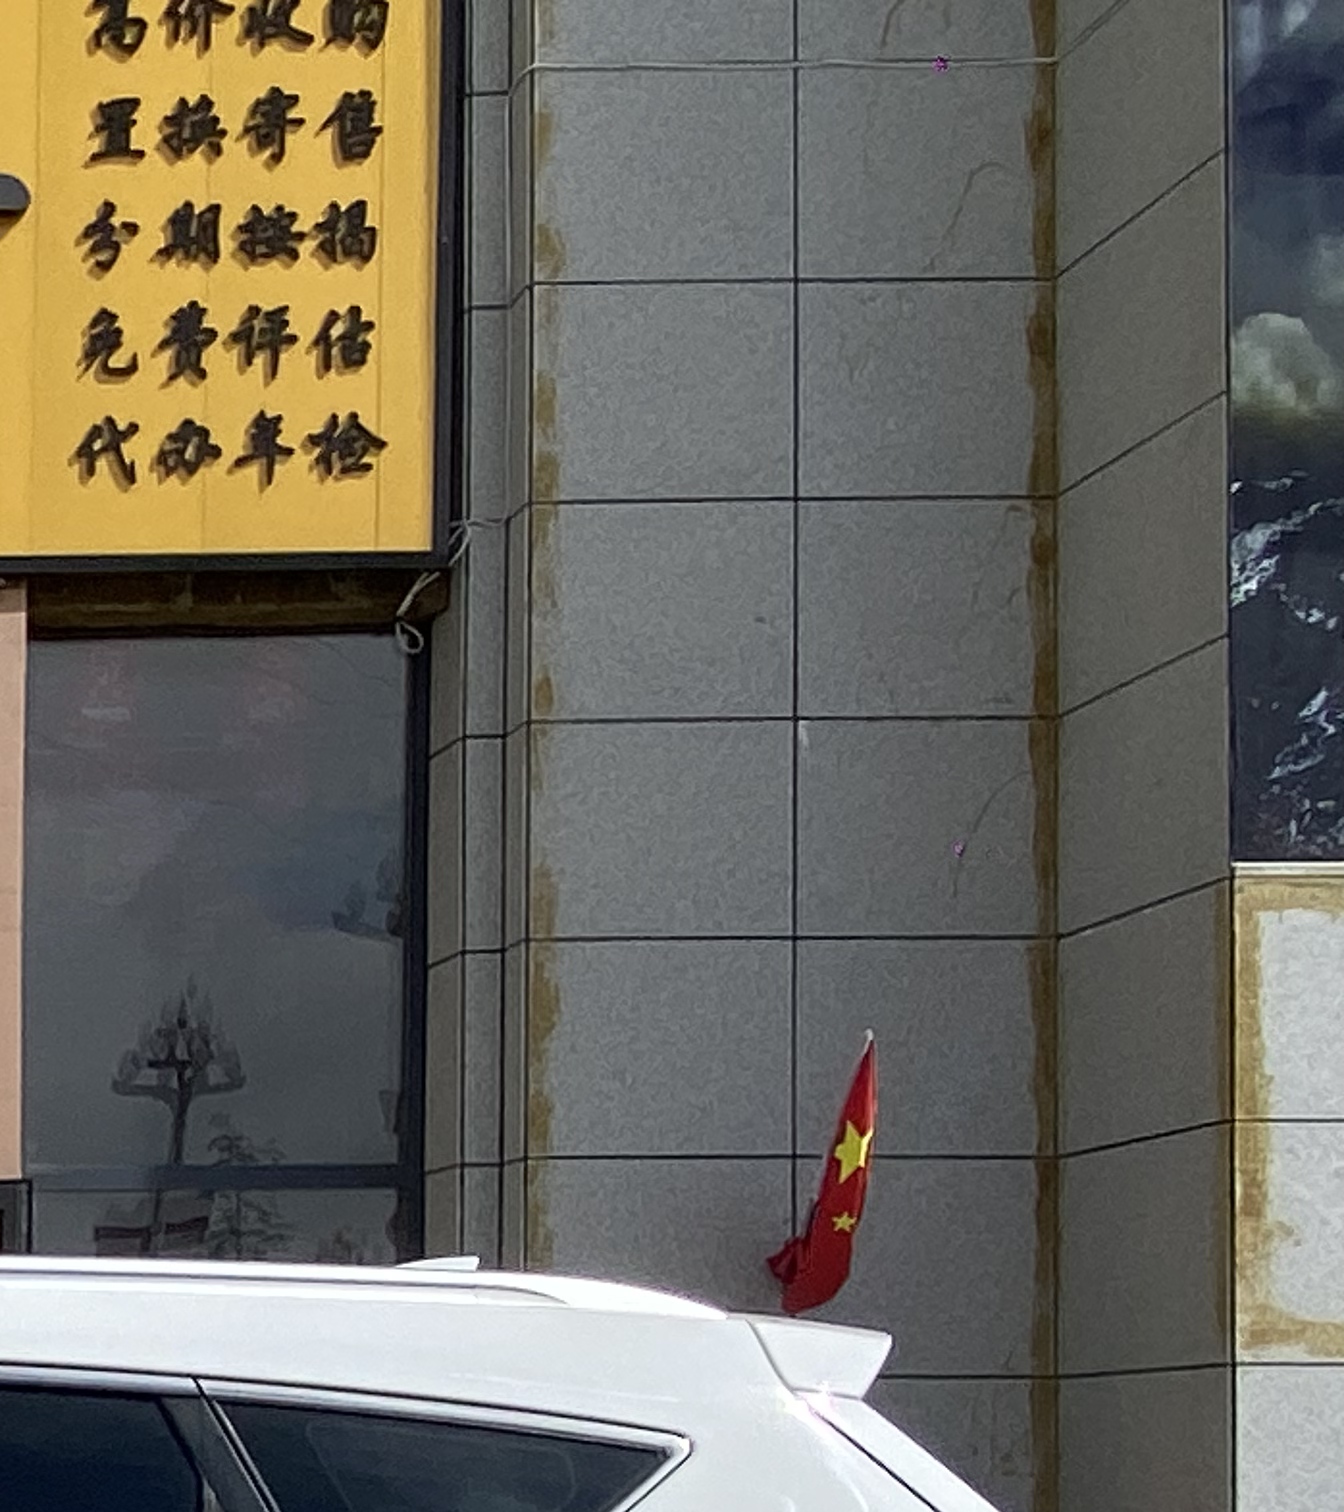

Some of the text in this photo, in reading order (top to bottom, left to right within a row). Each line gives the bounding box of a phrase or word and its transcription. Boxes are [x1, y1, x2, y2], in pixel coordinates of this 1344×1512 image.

[87, 87, 384, 167] 置换寄售
[78, 200, 378, 277] 分期按揭
[78, 301, 377, 386] 免费评估
[70, 410, 389, 490] 代办年检
